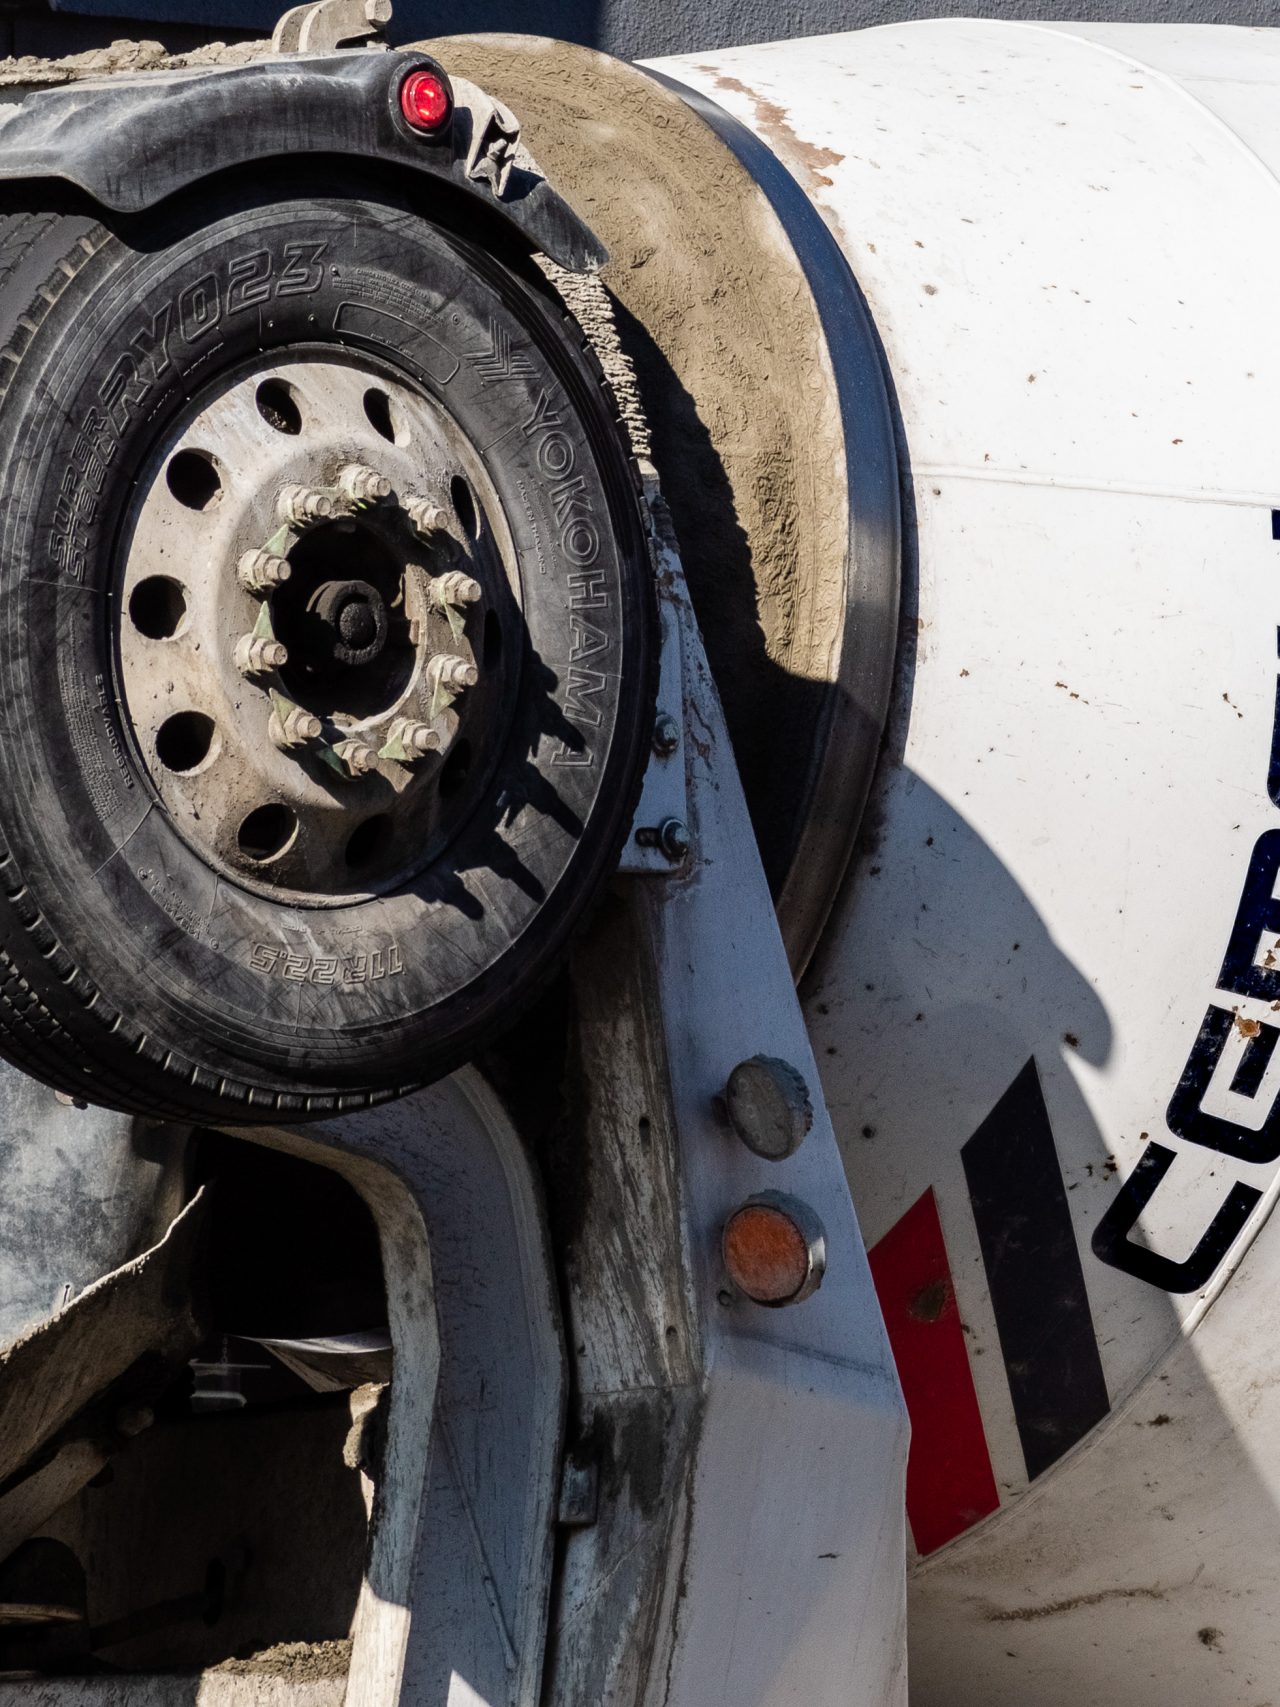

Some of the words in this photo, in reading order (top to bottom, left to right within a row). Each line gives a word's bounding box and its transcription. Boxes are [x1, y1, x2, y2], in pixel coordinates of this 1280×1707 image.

[47, 405, 108, 568] SUPER
[65, 428, 119, 582] STEEL
[519, 387, 612, 767] YOKOHAMA
